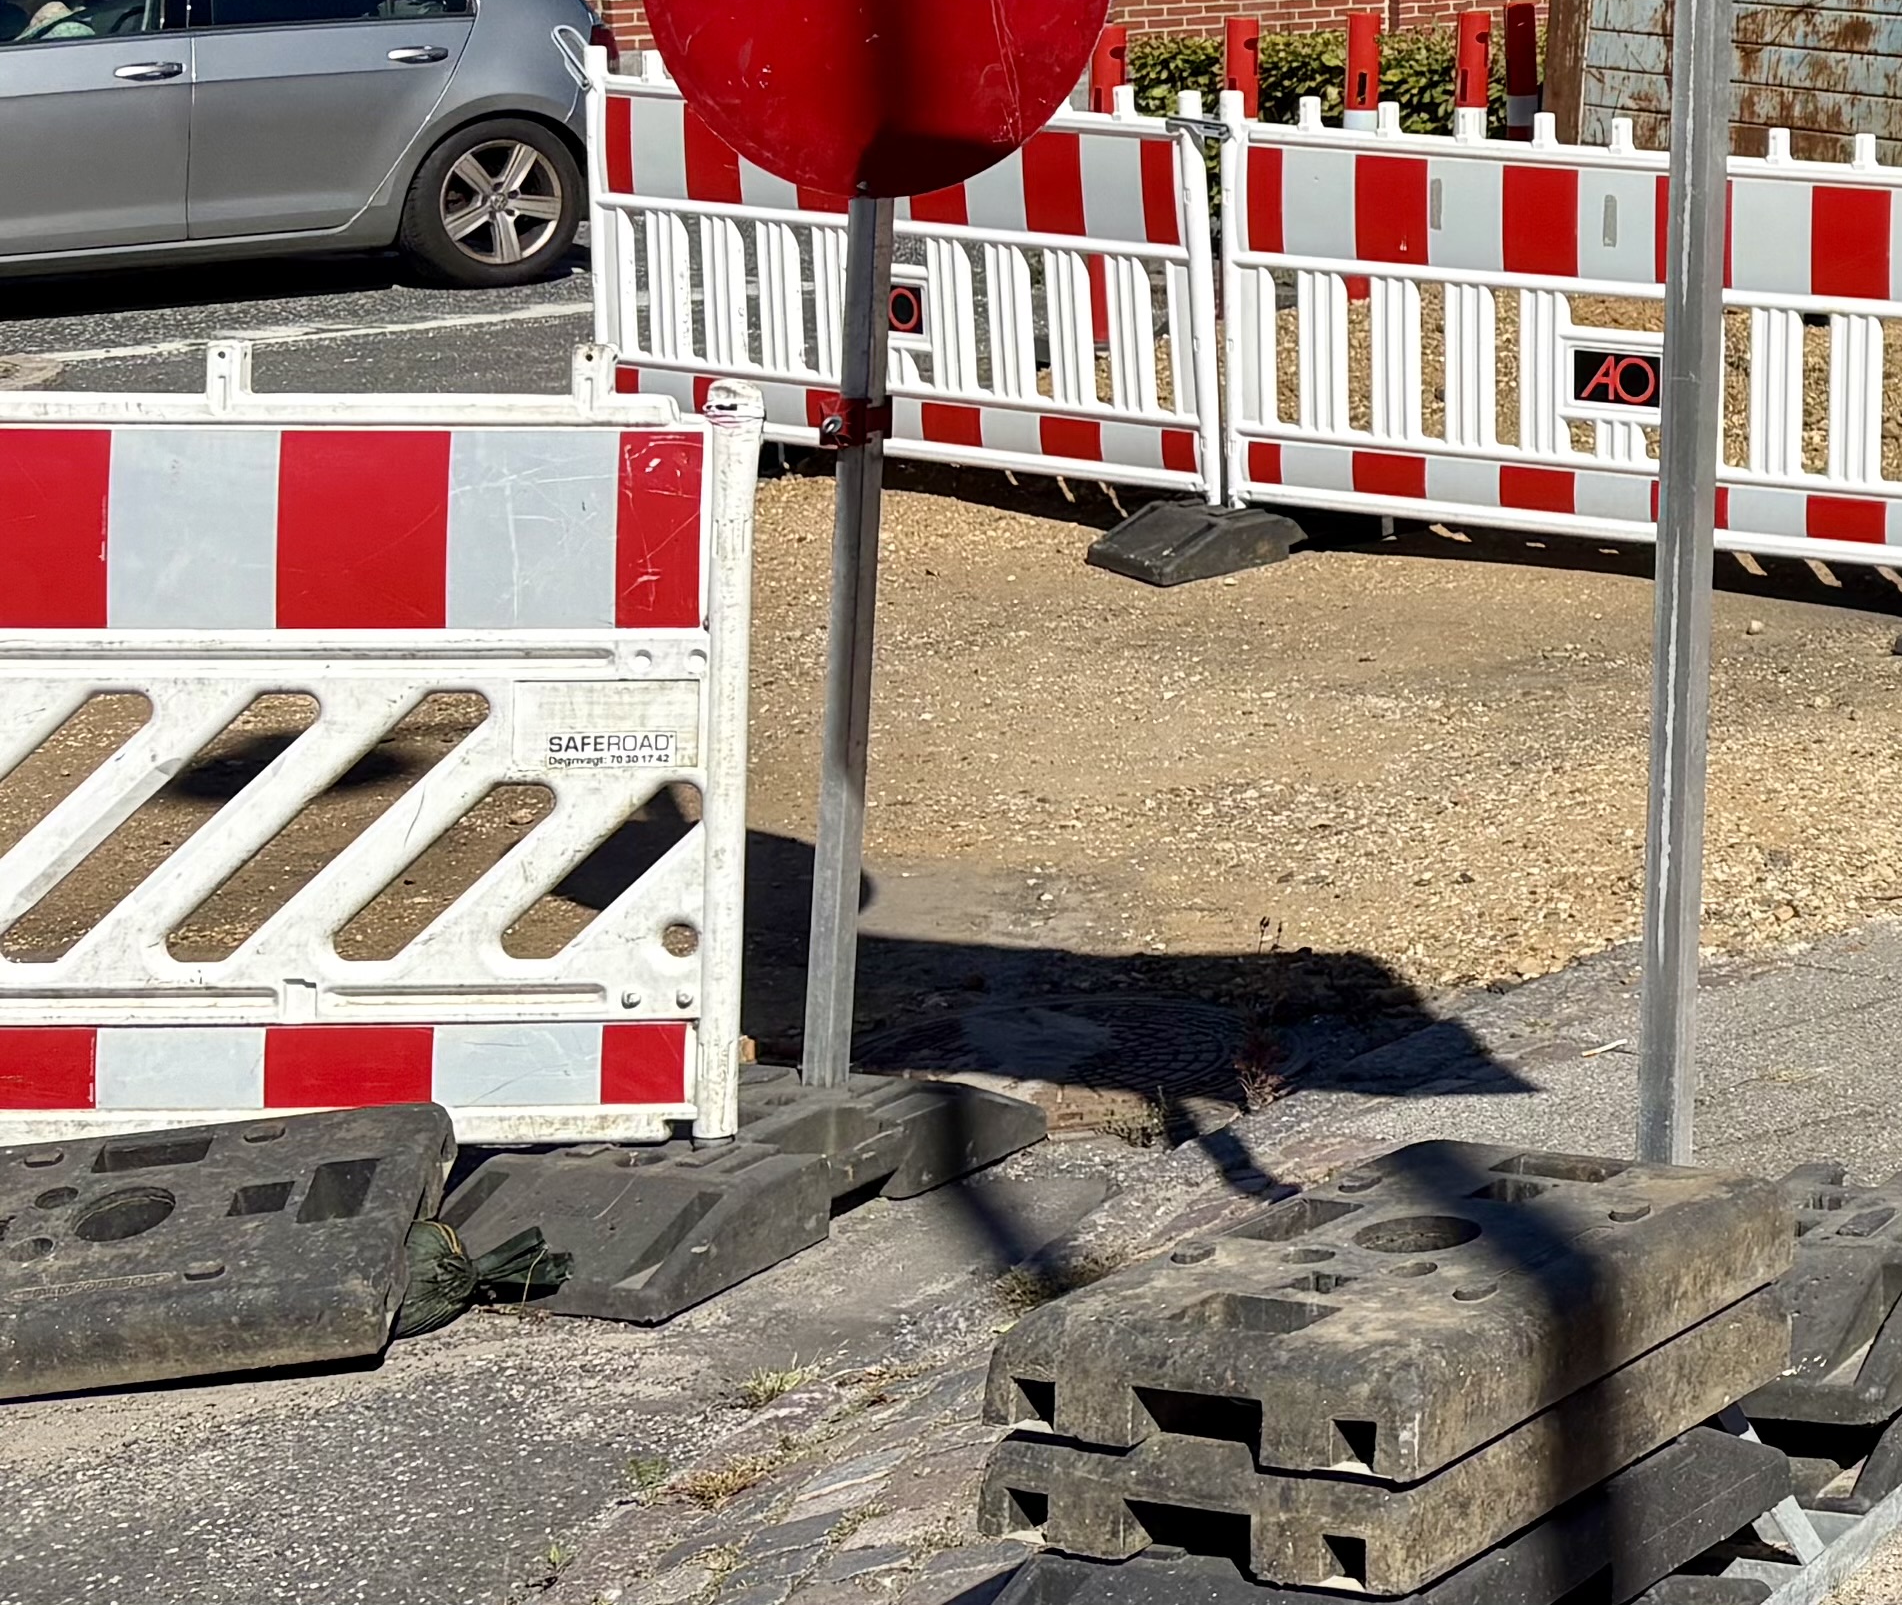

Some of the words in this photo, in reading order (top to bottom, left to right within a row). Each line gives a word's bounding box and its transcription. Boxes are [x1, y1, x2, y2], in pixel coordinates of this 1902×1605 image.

[1580, 354, 1656, 404] AO
[548, 733, 670, 753] SAFEROAD
[610, 754, 623, 764] 70
[625, 754, 639, 764] 30
[641, 754, 654, 764] 17
[655, 753, 670, 763] 42
